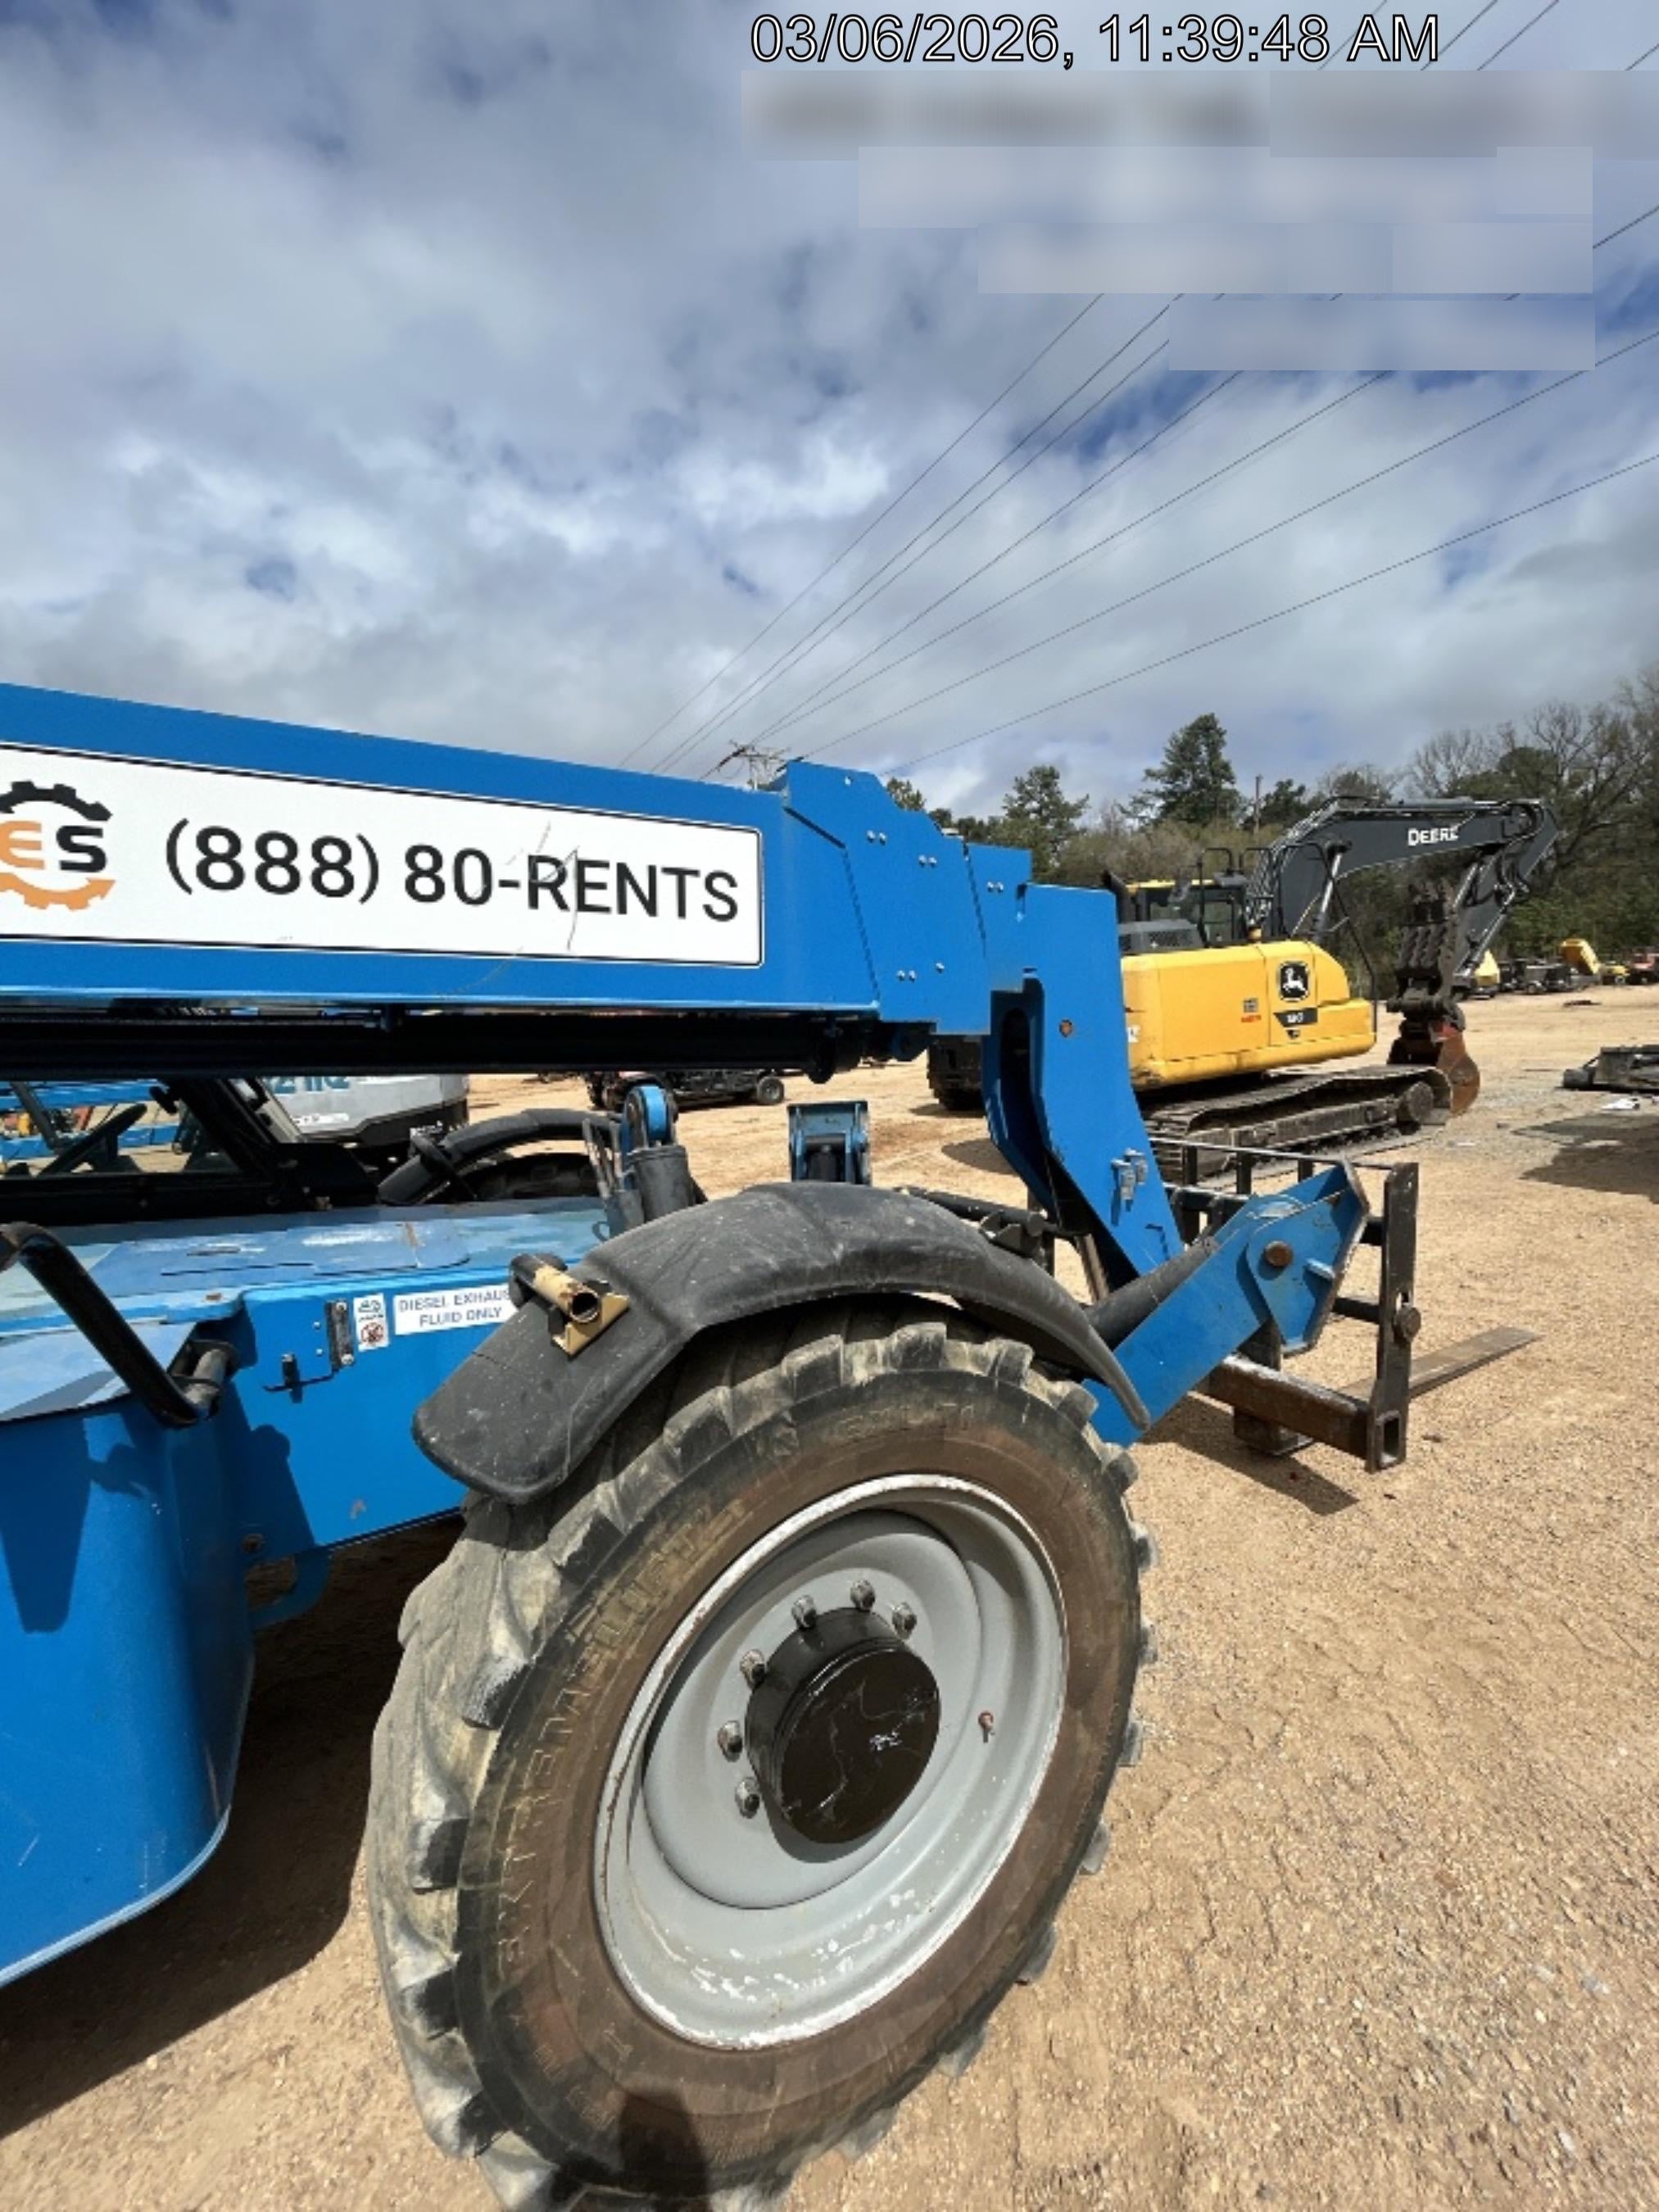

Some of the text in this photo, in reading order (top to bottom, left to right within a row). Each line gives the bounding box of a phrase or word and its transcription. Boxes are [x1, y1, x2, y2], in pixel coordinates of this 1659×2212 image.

[1407, 827, 1458, 846] DEERE
[166, 818, 737, 922] (888) 80-RENTS
[398, 1295, 446, 1312] DIESEL
[454, 1289, 510, 1306] EXHAUS
[419, 1306, 501, 1328] FLUID ONLY
